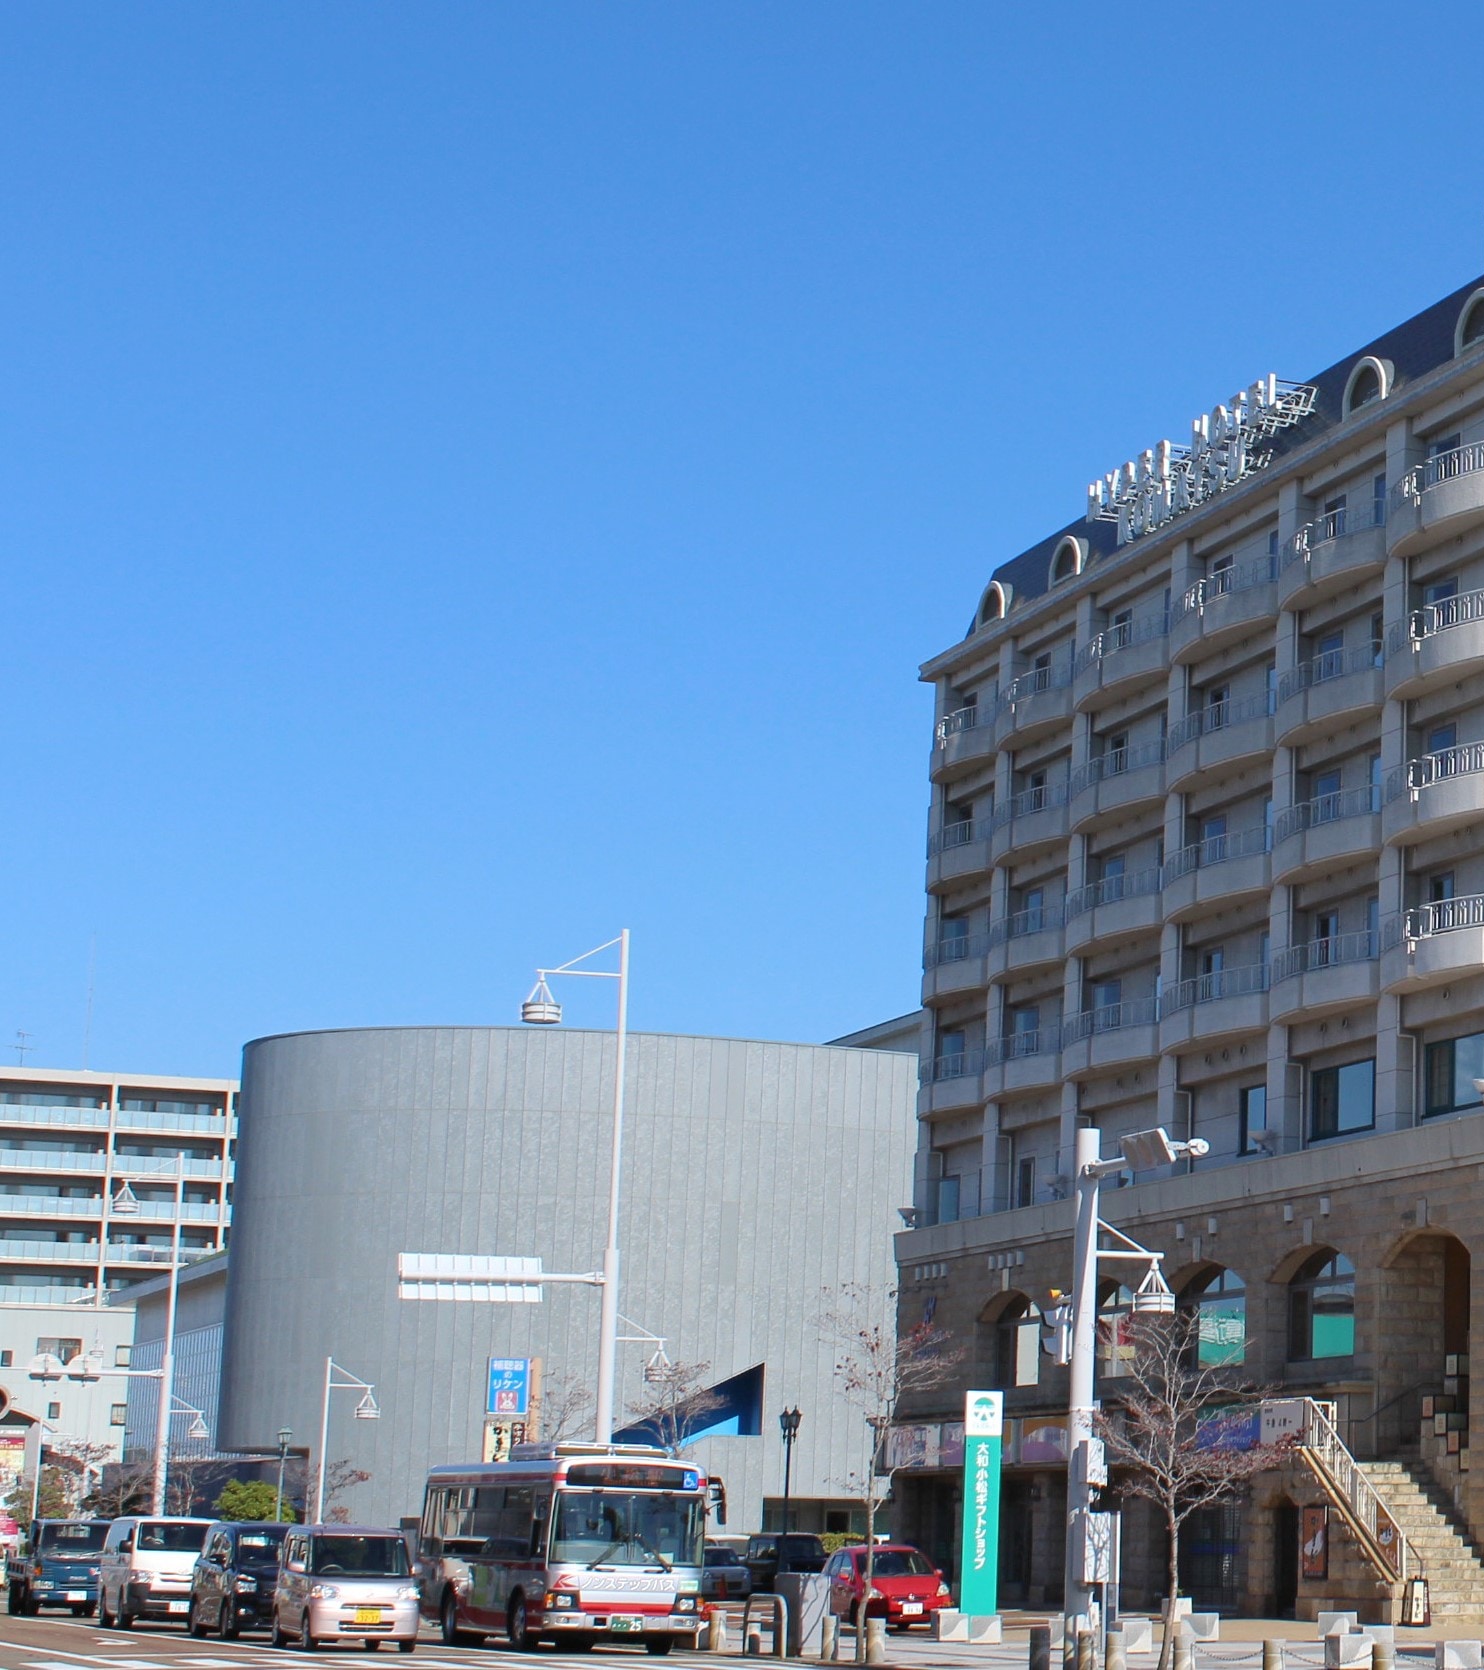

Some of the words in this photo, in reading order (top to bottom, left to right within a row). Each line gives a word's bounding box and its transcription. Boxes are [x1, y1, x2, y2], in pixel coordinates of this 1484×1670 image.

[504, 1371, 513, 1379] の
[493, 1379, 524, 1389] リケン
[582, 1577, 675, 1591] ノンステップバス
